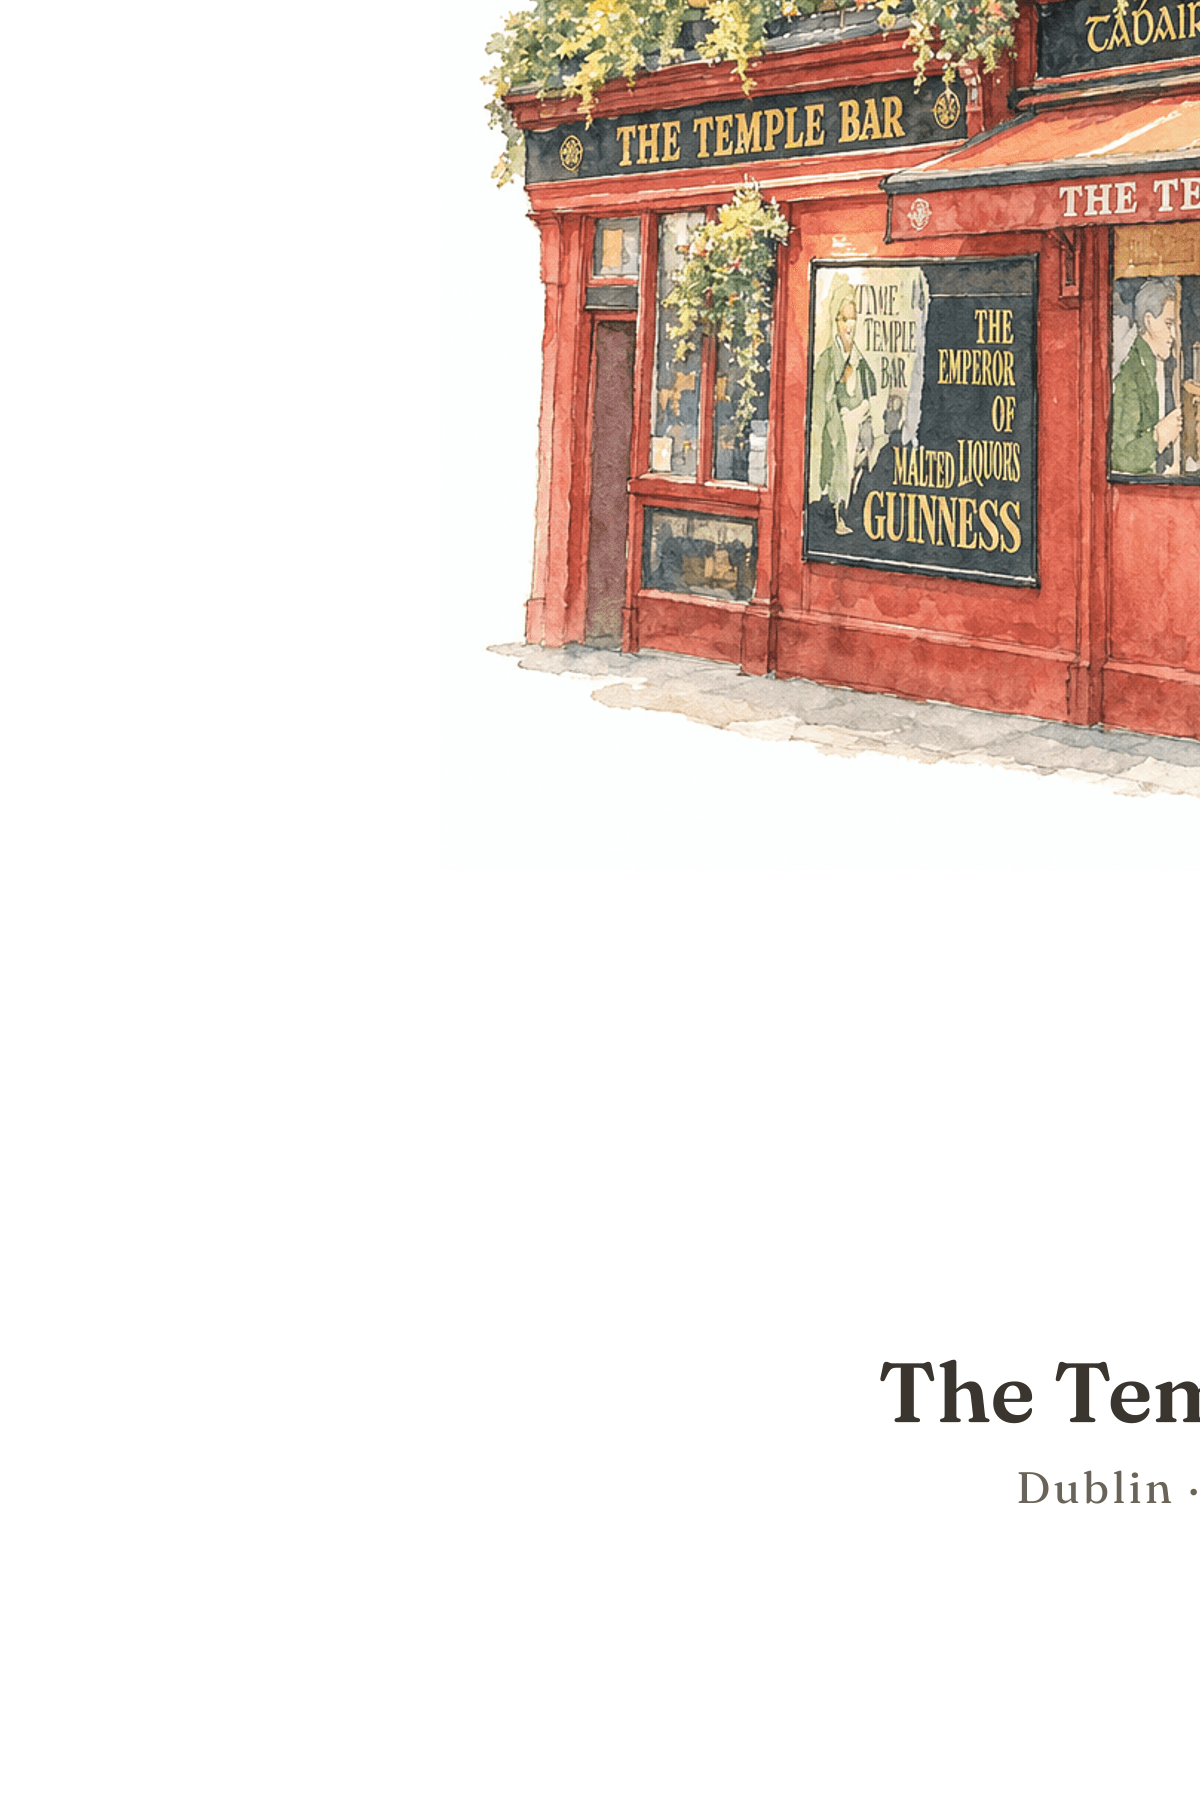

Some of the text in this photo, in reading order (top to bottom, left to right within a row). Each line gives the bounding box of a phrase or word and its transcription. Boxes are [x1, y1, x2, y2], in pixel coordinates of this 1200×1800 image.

[616, 95, 906, 166] THE TEMPLE BAR
[1059, 181, 1138, 218] THE
[864, 318, 917, 353] TEMPLE
[974, 309, 1014, 345] THE
[937, 349, 1016, 387] EMPEROR
[991, 395, 1016, 433] OF
[892, 439, 1021, 489] MALTED LIQUORS
[863, 490, 1022, 554] GUINNESS
